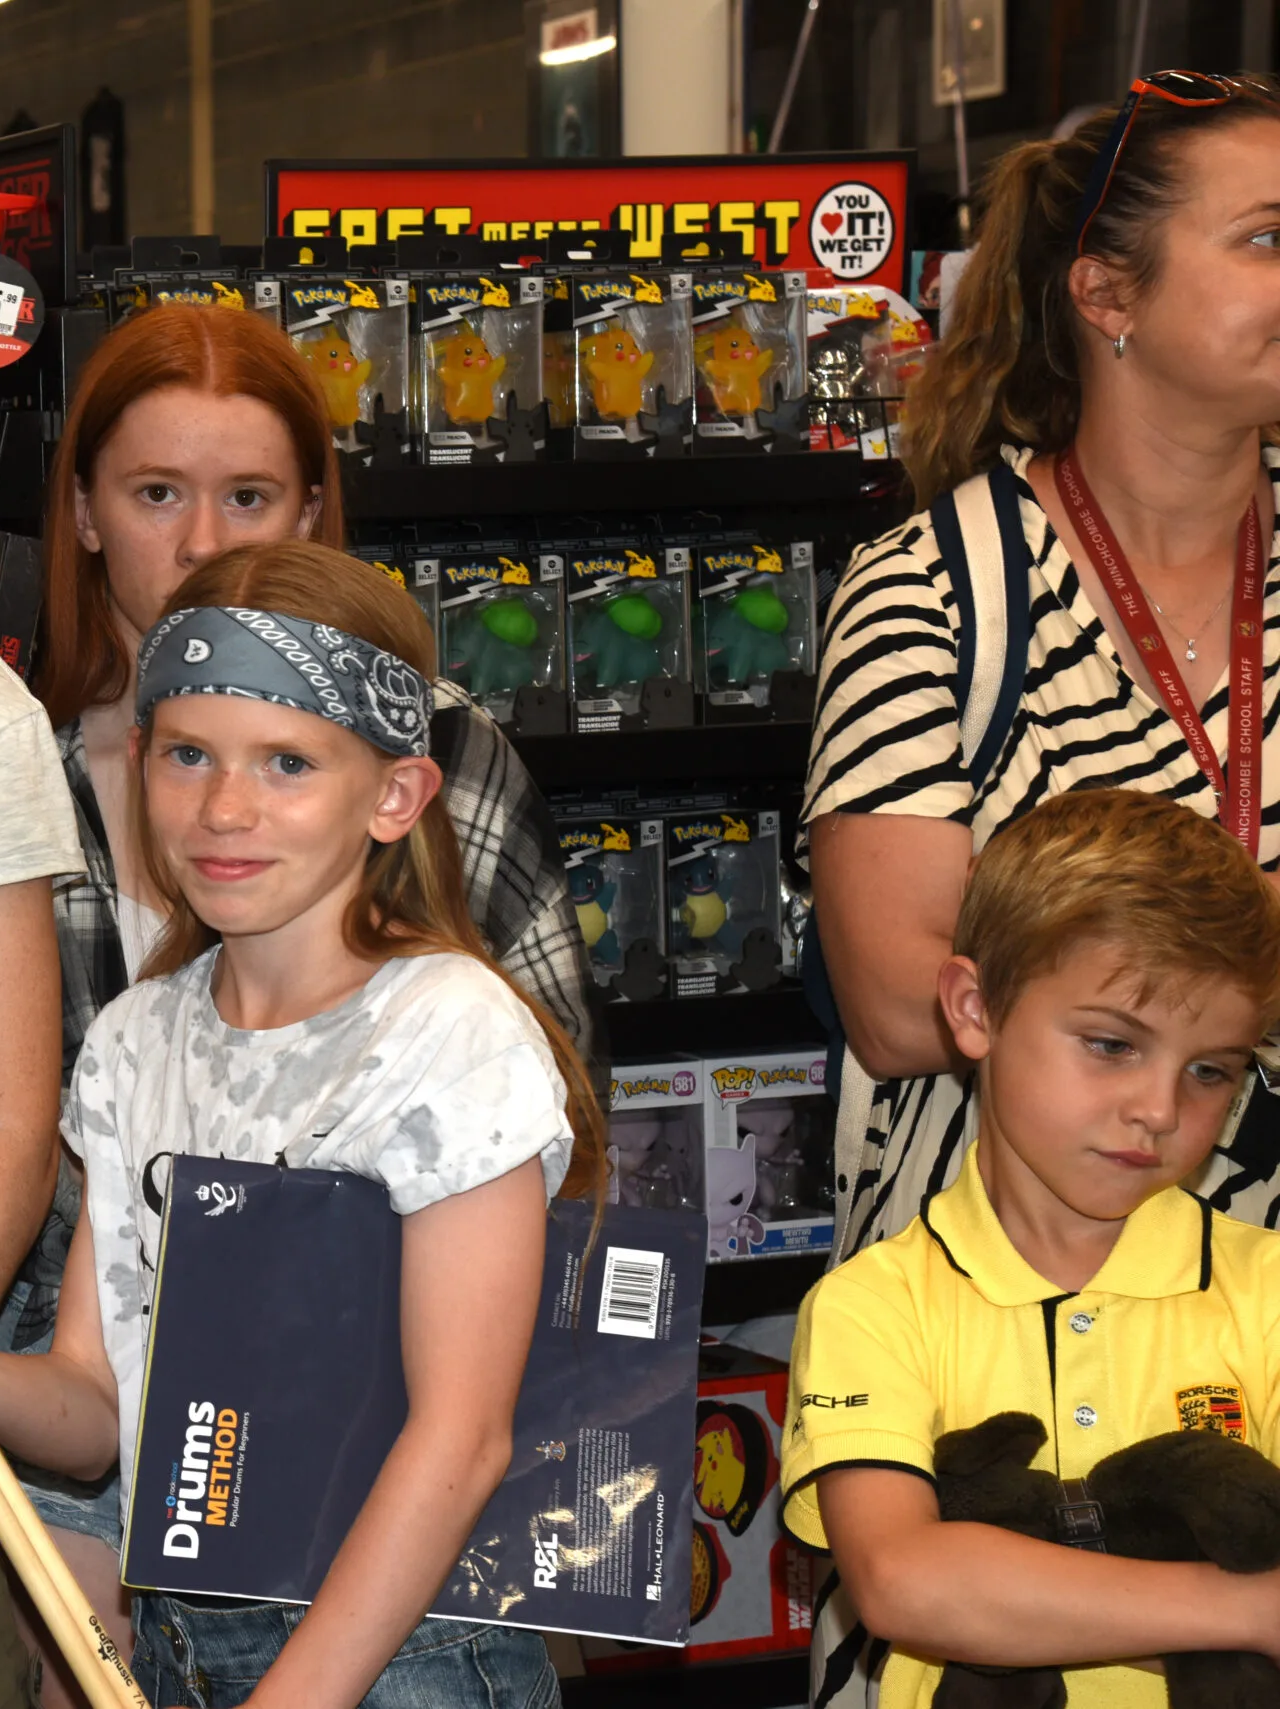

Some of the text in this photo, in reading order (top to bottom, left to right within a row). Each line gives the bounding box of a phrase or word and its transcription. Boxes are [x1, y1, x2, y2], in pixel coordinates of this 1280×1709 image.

[834, 194, 870, 210] YOU
[617, 200, 801, 258] WEST
[847, 210, 886, 236] IT!
[819, 237, 886, 254] WE GET
[839, 252, 864, 270] IT!
[429, 448, 473, 456] TRANSLUCENT
[1078, 508, 1128, 591] WINCHCOMBE
[1243, 576, 1255, 601] THE
[1121, 593, 1141, 617] THE
[1241, 656, 1254, 697] STAFF
[578, 715, 621, 723] TRANSLUCENT
[1158, 669, 1211, 762] SCHOOL STAFF
[1240, 699, 1253, 754] SCHOOL
[674, 1076, 694, 1091] 581
[711, 1067, 756, 1092] POP!
[811, 1066, 826, 1082] 58
[1178, 1384, 1239, 1400] PORSCHE
[162, 1401, 216, 1559] Drums
[205, 1408, 239, 1527] METHOD
[229, 1410, 251, 1528] Popular Drums For Beginners
[534, 1532, 559, 1589] RSL
